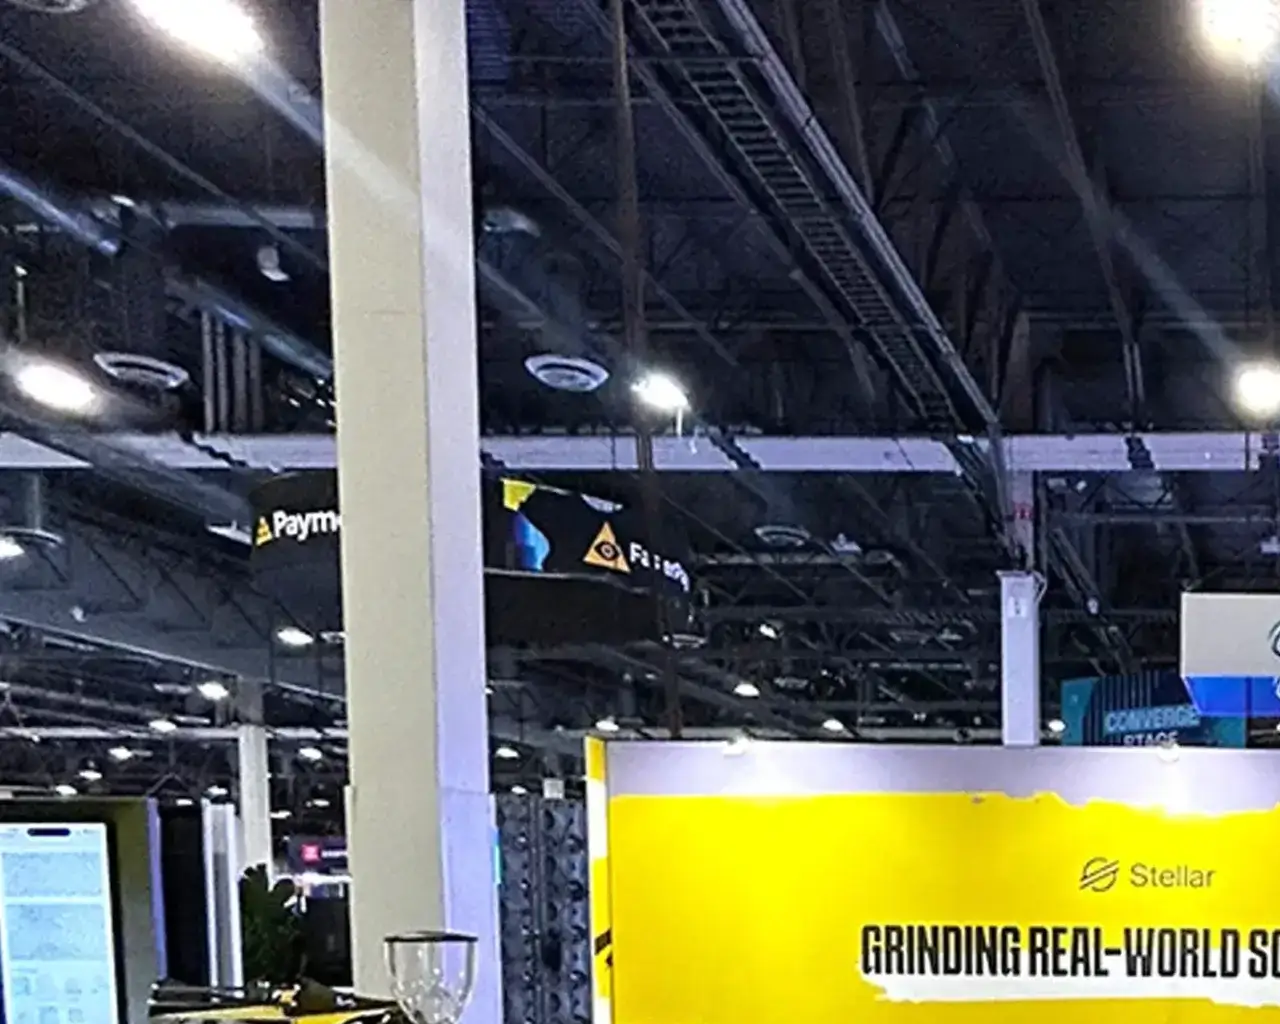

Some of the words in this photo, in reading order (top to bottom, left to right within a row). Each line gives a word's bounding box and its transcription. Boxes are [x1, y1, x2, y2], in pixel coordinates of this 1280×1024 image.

[1129, 863, 1217, 889] Stellar
[861, 925, 1020, 977] GRINDING
[1028, 926, 1239, 979] REAL-WORLD
